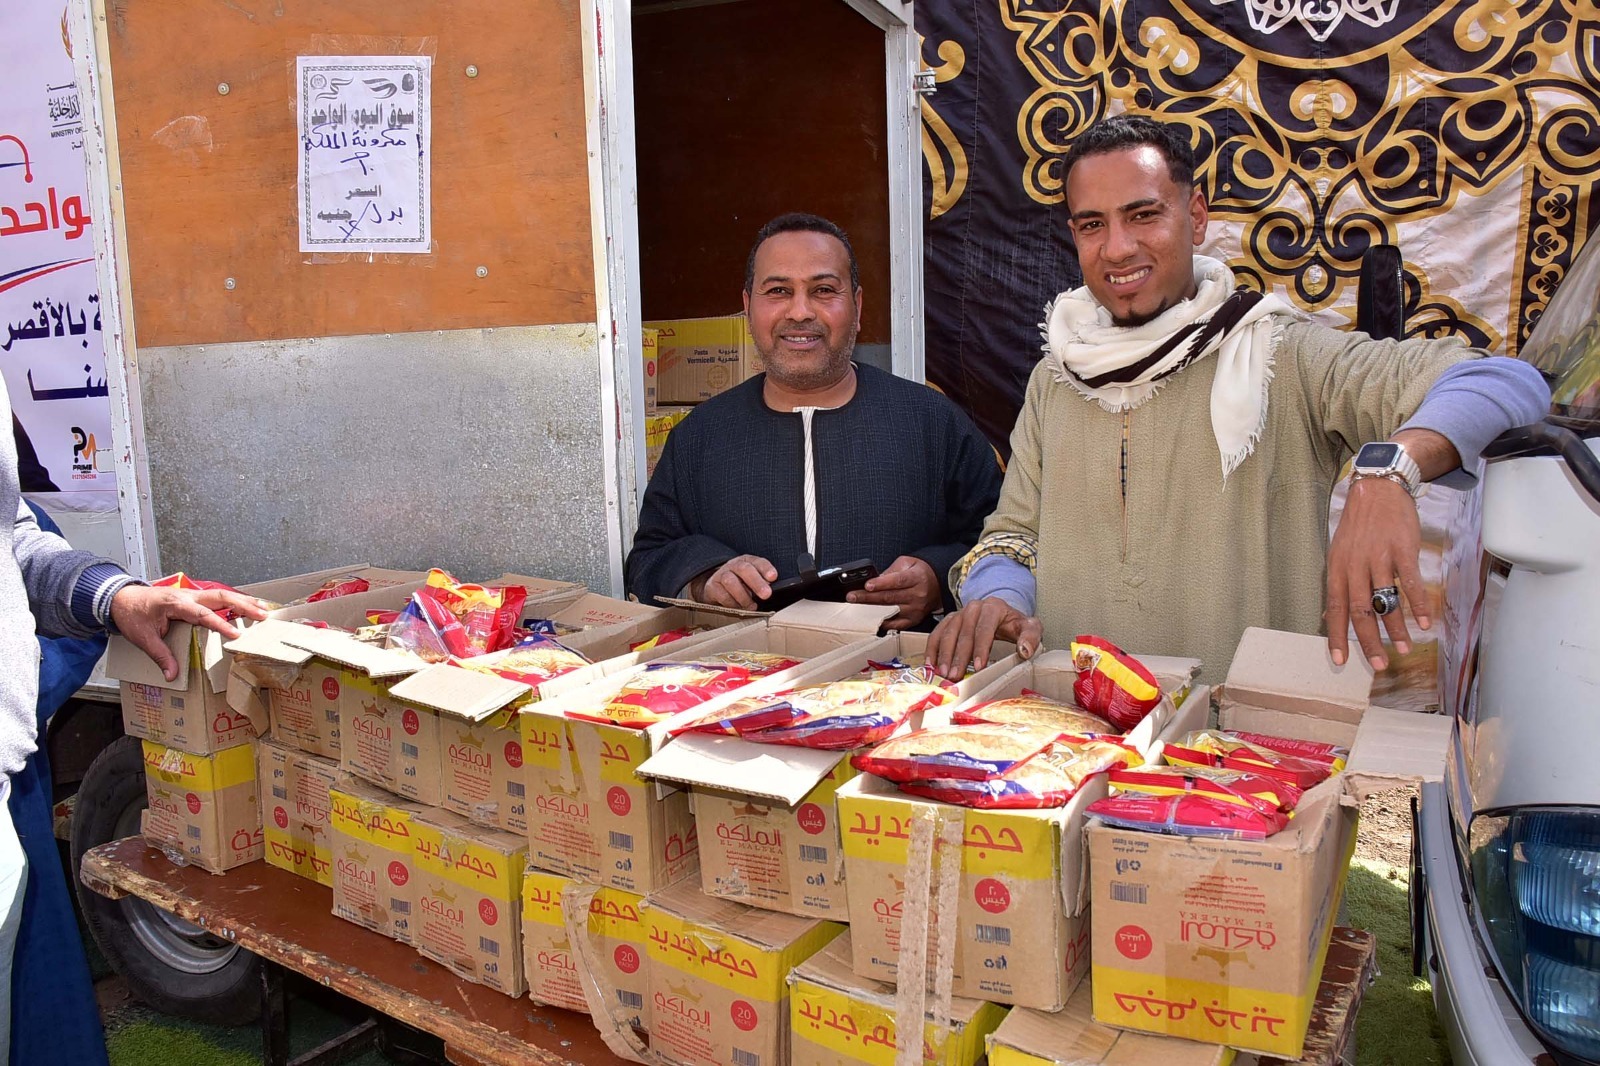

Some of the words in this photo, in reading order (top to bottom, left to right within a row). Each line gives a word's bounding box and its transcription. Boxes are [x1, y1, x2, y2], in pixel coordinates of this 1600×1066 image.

[311, 102, 347, 131] الواحد
[353, 102, 382, 131] اليوم
[388, 103, 414, 130] سوق
[51, 128, 74, 138] MINISTRY
[75, 126, 82, 134] OF
[353, 127, 410, 149] مكرونة
[345, 185, 382, 201] السعر
[0, 187, 91, 240] واحد
[317, 207, 352, 223] جنيه
[1, 296, 87, 351] بالأقصر
[687, 356, 716, 364] Vermicelli
[217, 732, 236, 744] EL
[352, 716, 390, 742] الملكة
[448, 744, 492, 769] الملكة
[536, 794, 590, 818] الملكة
[613, 794, 626, 806] 20
[334, 800, 365, 828] جديد
[554, 812, 591, 826] MALEKA
[802, 820, 823, 828] كيس
[808, 810, 816, 818] ٢٠
[366, 812, 410, 839] حجم
[716, 822, 782, 847] الملكة
[236, 850, 254, 862] EL
[270, 841, 307, 865] حجم
[738, 842, 784, 855] MALEKA
[337, 858, 376, 886] الملكة
[454, 852, 498, 880] حجم
[390, 873, 406, 882] كيس
[981, 896, 1006, 906] كيس
[988, 886, 997, 896] ٢٠
[420, 896, 464, 924] الملكة
[482, 904, 494, 916] 20
[1178, 911, 1244, 926] MALEKA
[1180, 920, 1276, 950] الملكة
[1254, 920, 1274, 930] EL
[649, 926, 697, 962] جديد
[1119, 932, 1146, 942] كيس
[1128, 942, 1138, 952] ٢٠
[620, 951, 634, 963] 20
[654, 991, 710, 1026] الملكة
[737, 1006, 751, 1020] 20
[1114, 990, 1198, 1020] حجم
[1203, 1000, 1286, 1036] جديد
[656, 1006, 668, 1014] EL
[672, 1012, 712, 1034] MALEKA
[799, 998, 858, 1042] جديد
